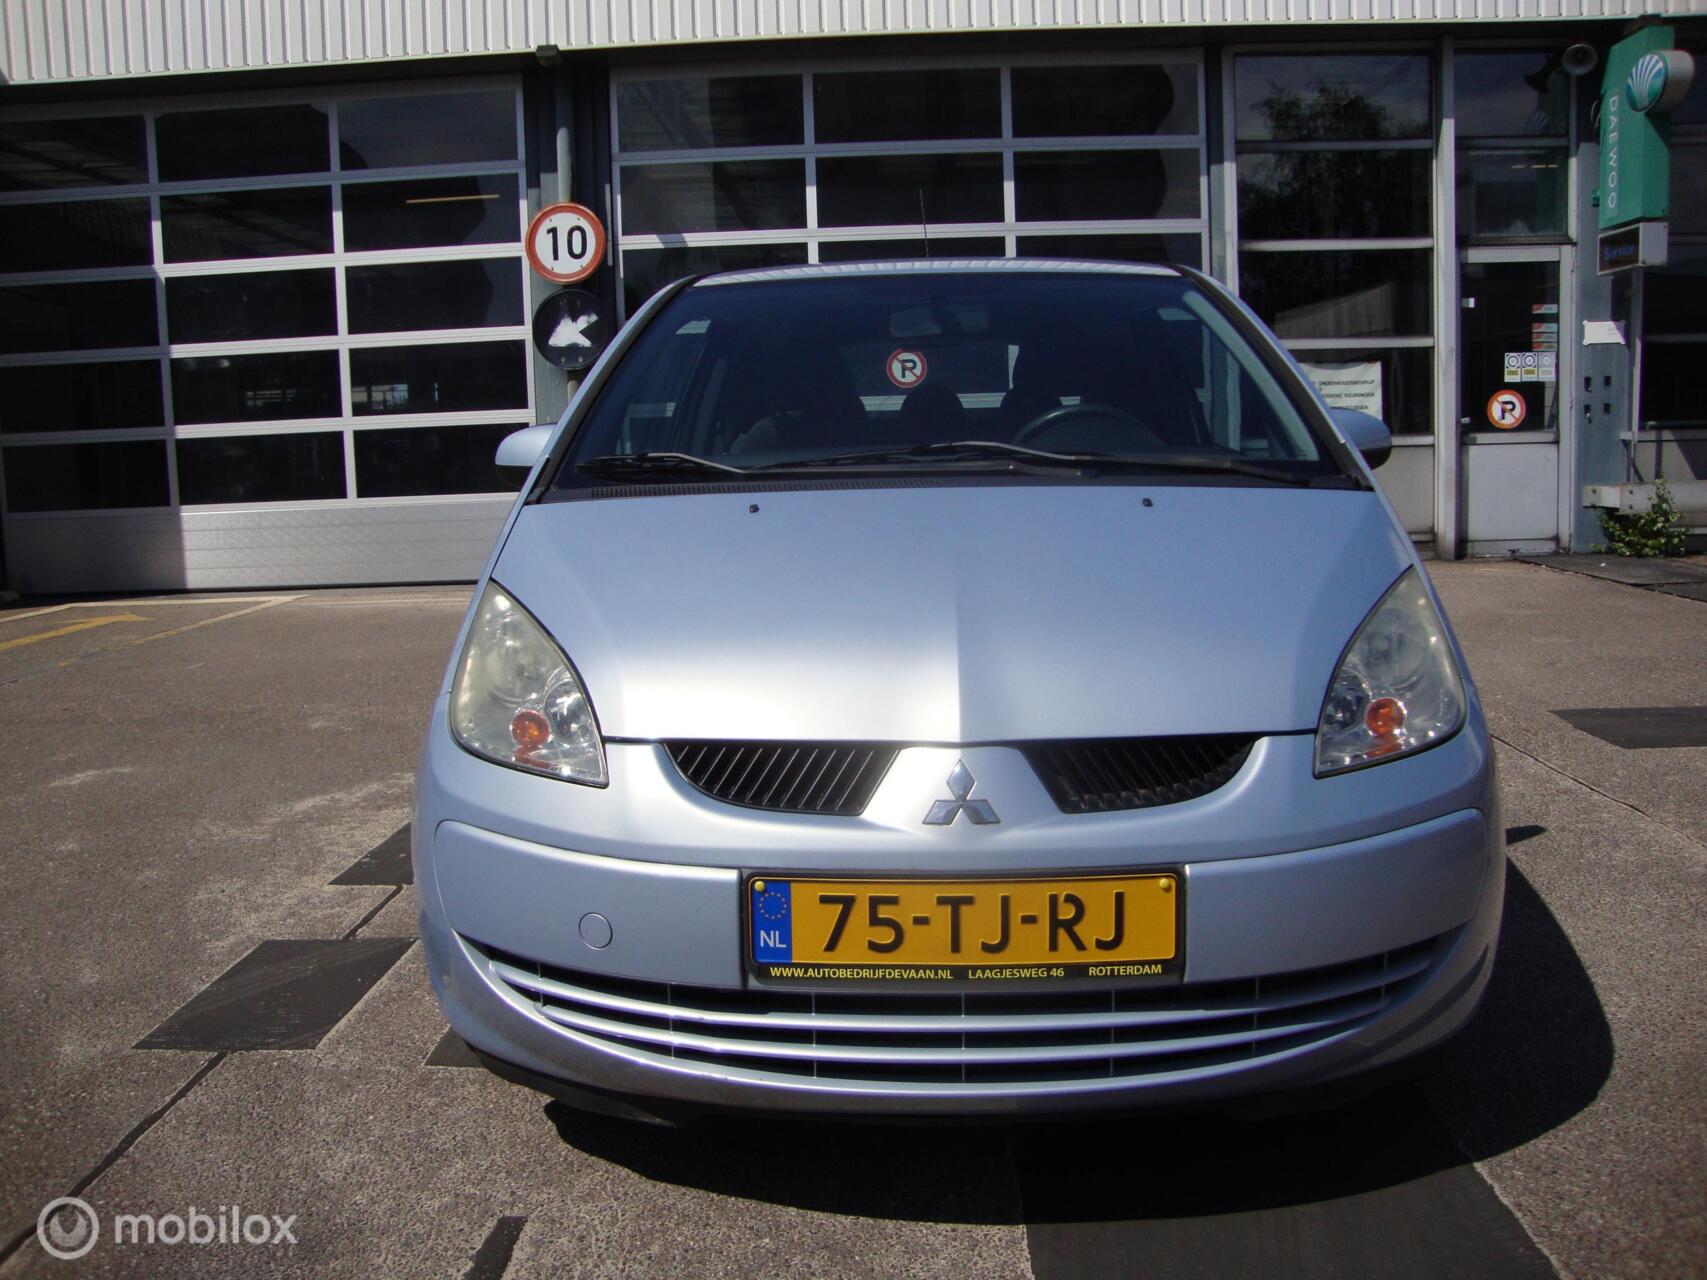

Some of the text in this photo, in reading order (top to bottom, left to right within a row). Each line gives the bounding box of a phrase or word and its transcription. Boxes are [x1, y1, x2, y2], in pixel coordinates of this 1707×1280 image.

[1608, 95, 1618, 208] DAEWOO
[546, 225, 587, 261] 10
[760, 930, 787, 948] NL
[818, 891, 1125, 954] 75-TJ-RJ
[770, 964, 1162, 979] WWW.AUTOBEDRIJFDEVAAN.NL LAAGJESWEG 46 ROTTERDAM
